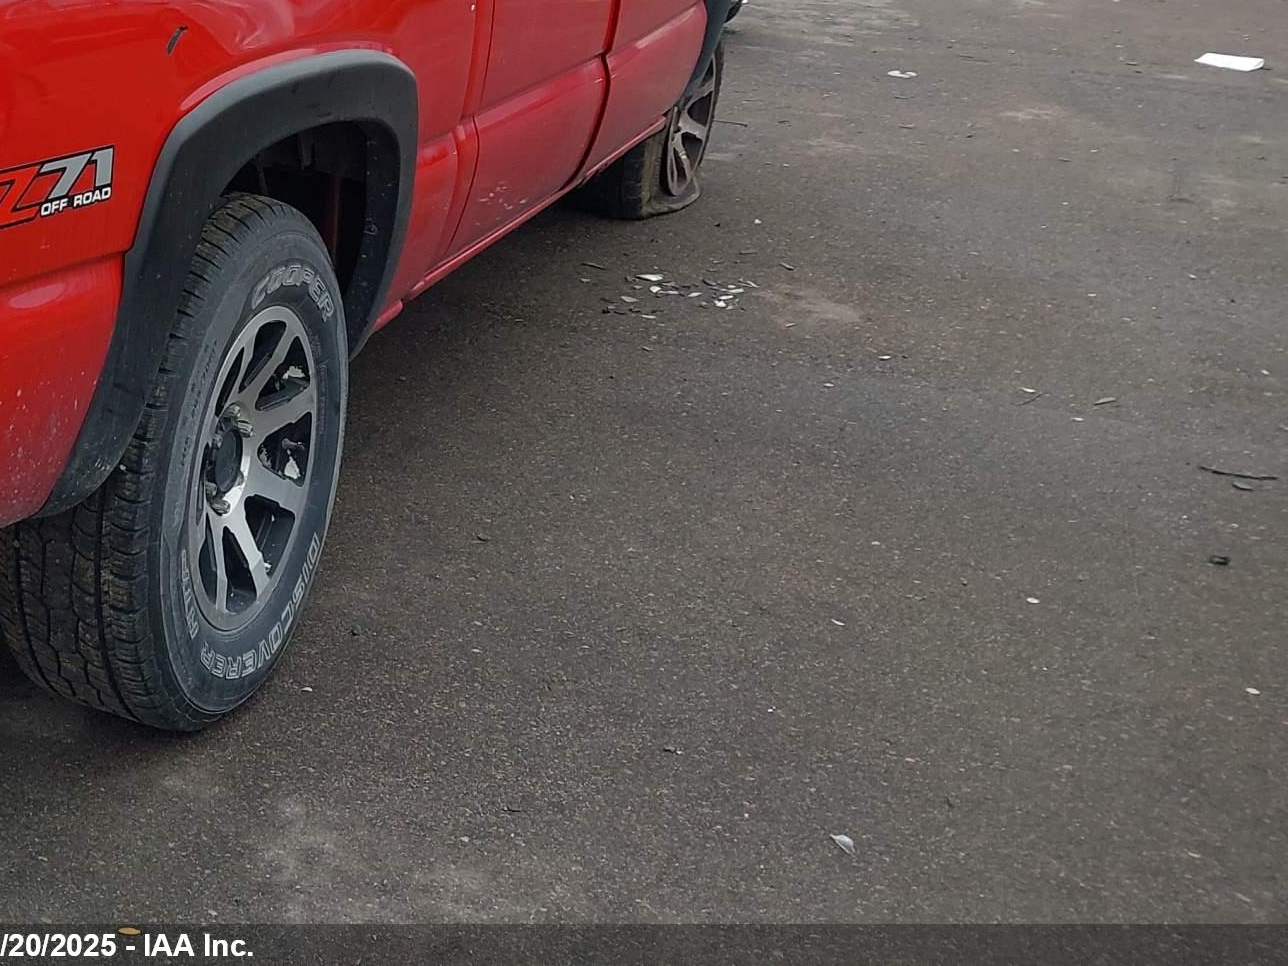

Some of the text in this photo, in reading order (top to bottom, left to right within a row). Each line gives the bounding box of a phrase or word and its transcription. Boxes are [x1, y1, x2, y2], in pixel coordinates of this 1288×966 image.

[40, 187, 111, 216] OFF ROAD
[248, 264, 335, 323] COOPER
[200, 532, 321, 680] DISCOVERER
